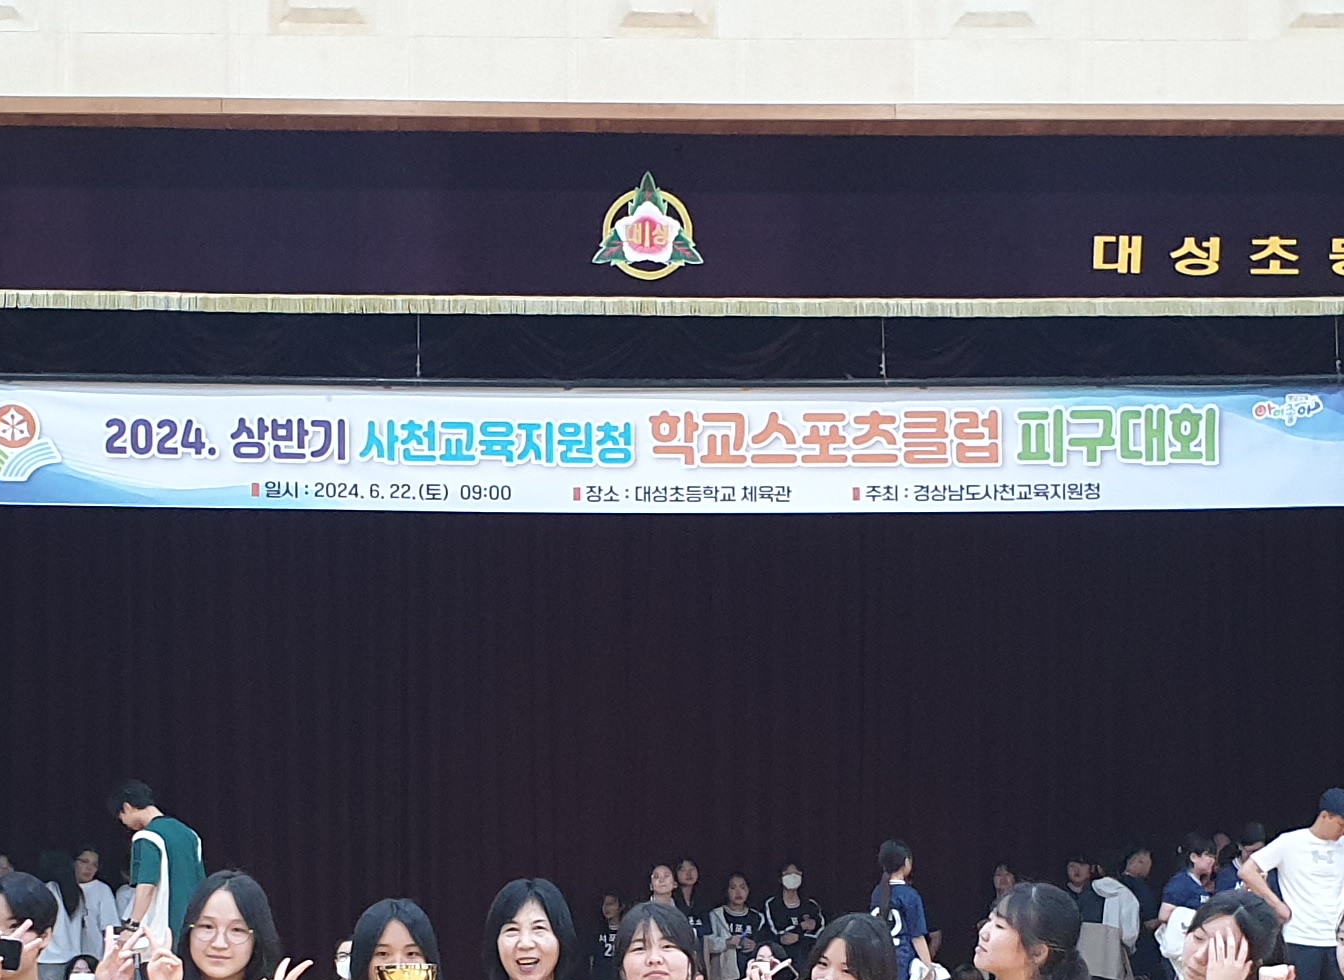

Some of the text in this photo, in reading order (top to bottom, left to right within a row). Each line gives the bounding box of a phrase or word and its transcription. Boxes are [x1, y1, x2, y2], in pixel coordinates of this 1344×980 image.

[106, 407, 1216, 466] 2024. 상반기 사천교육지원청 학교스포츠클럽 피구대회
[264, 480, 299, 499] 일시
[314, 482, 364, 500] 2024.
[460, 485, 511, 500] 09:00
[586, 485, 620, 502] 장소
[635, 485, 737, 503] 대성초등학교
[741, 485, 792, 503] 체육관
[864, 484, 898, 502] 주최
[913, 483, 1101, 501] 경상남도사천교육지원청
